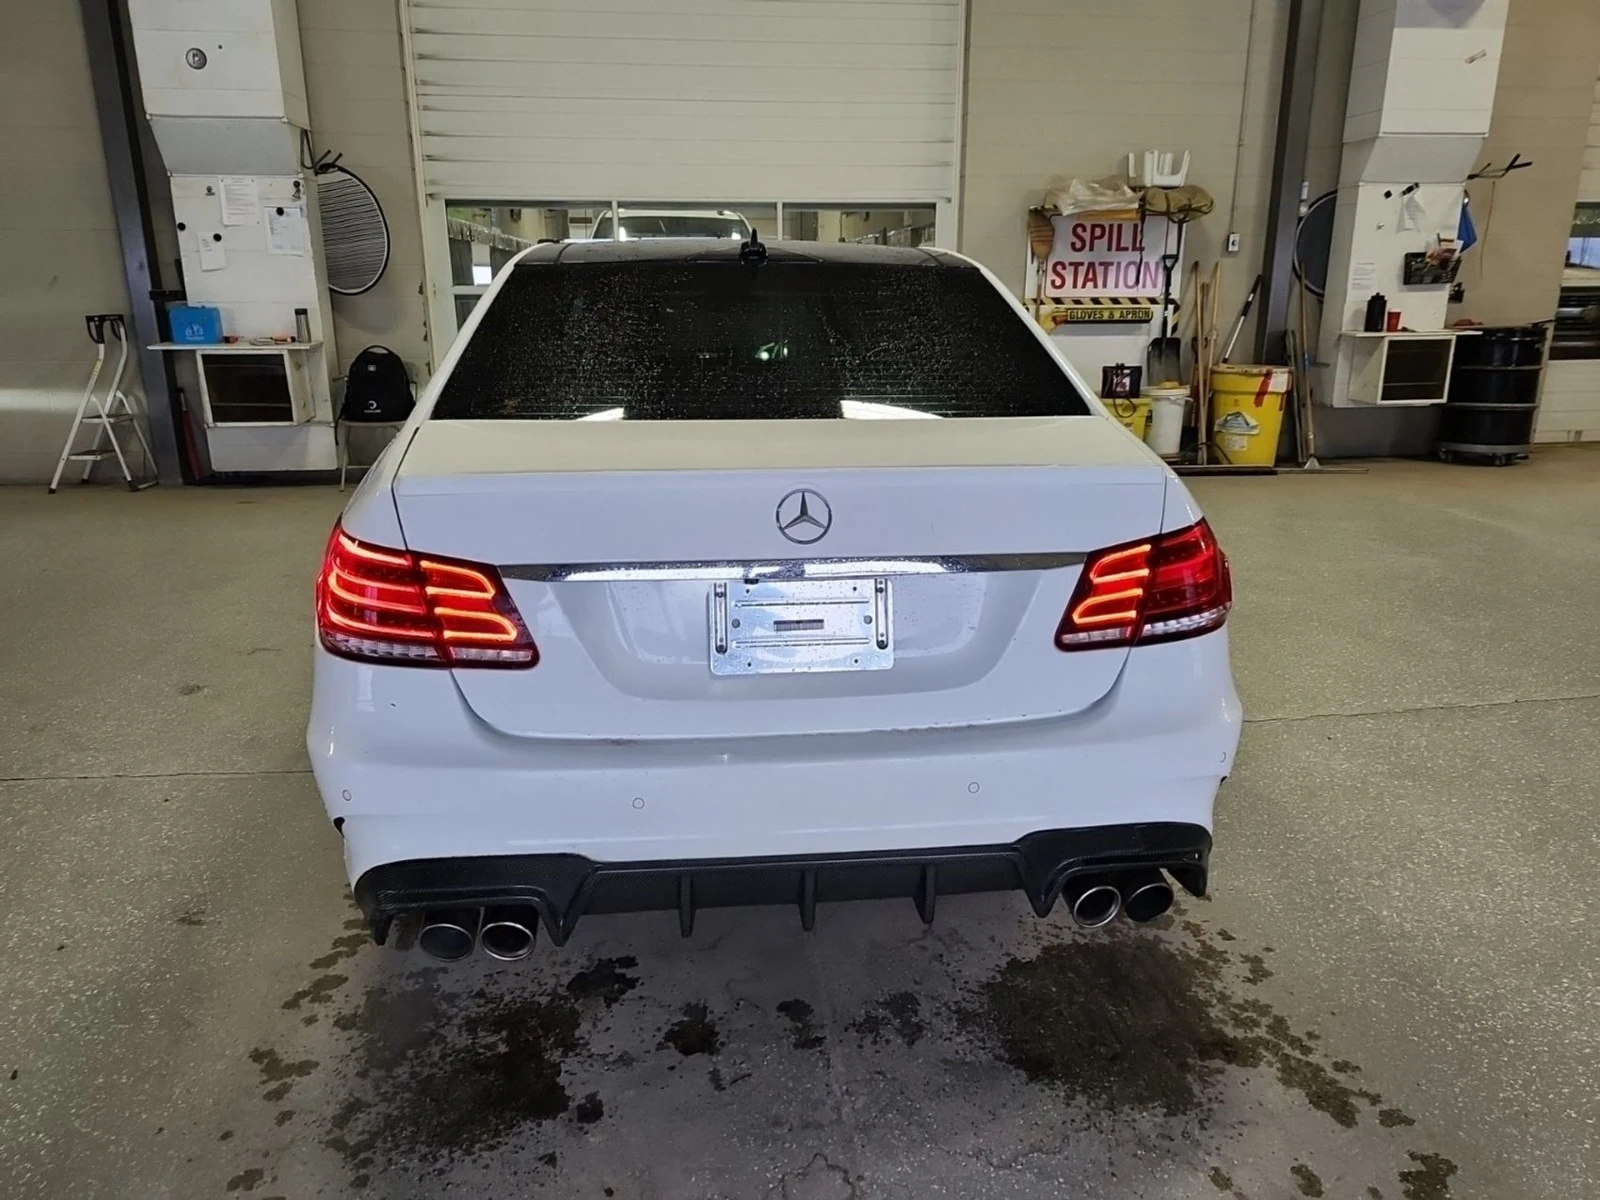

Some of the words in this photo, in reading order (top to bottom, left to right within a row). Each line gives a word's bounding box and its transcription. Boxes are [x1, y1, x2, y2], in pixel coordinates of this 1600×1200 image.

[1070, 223, 1145, 252] SPILL
[1050, 261, 1160, 289] STATION
[1069, 310, 1104, 320] GLOVES
[1107, 310, 1115, 320] &
[1119, 310, 1150, 320] APRON
